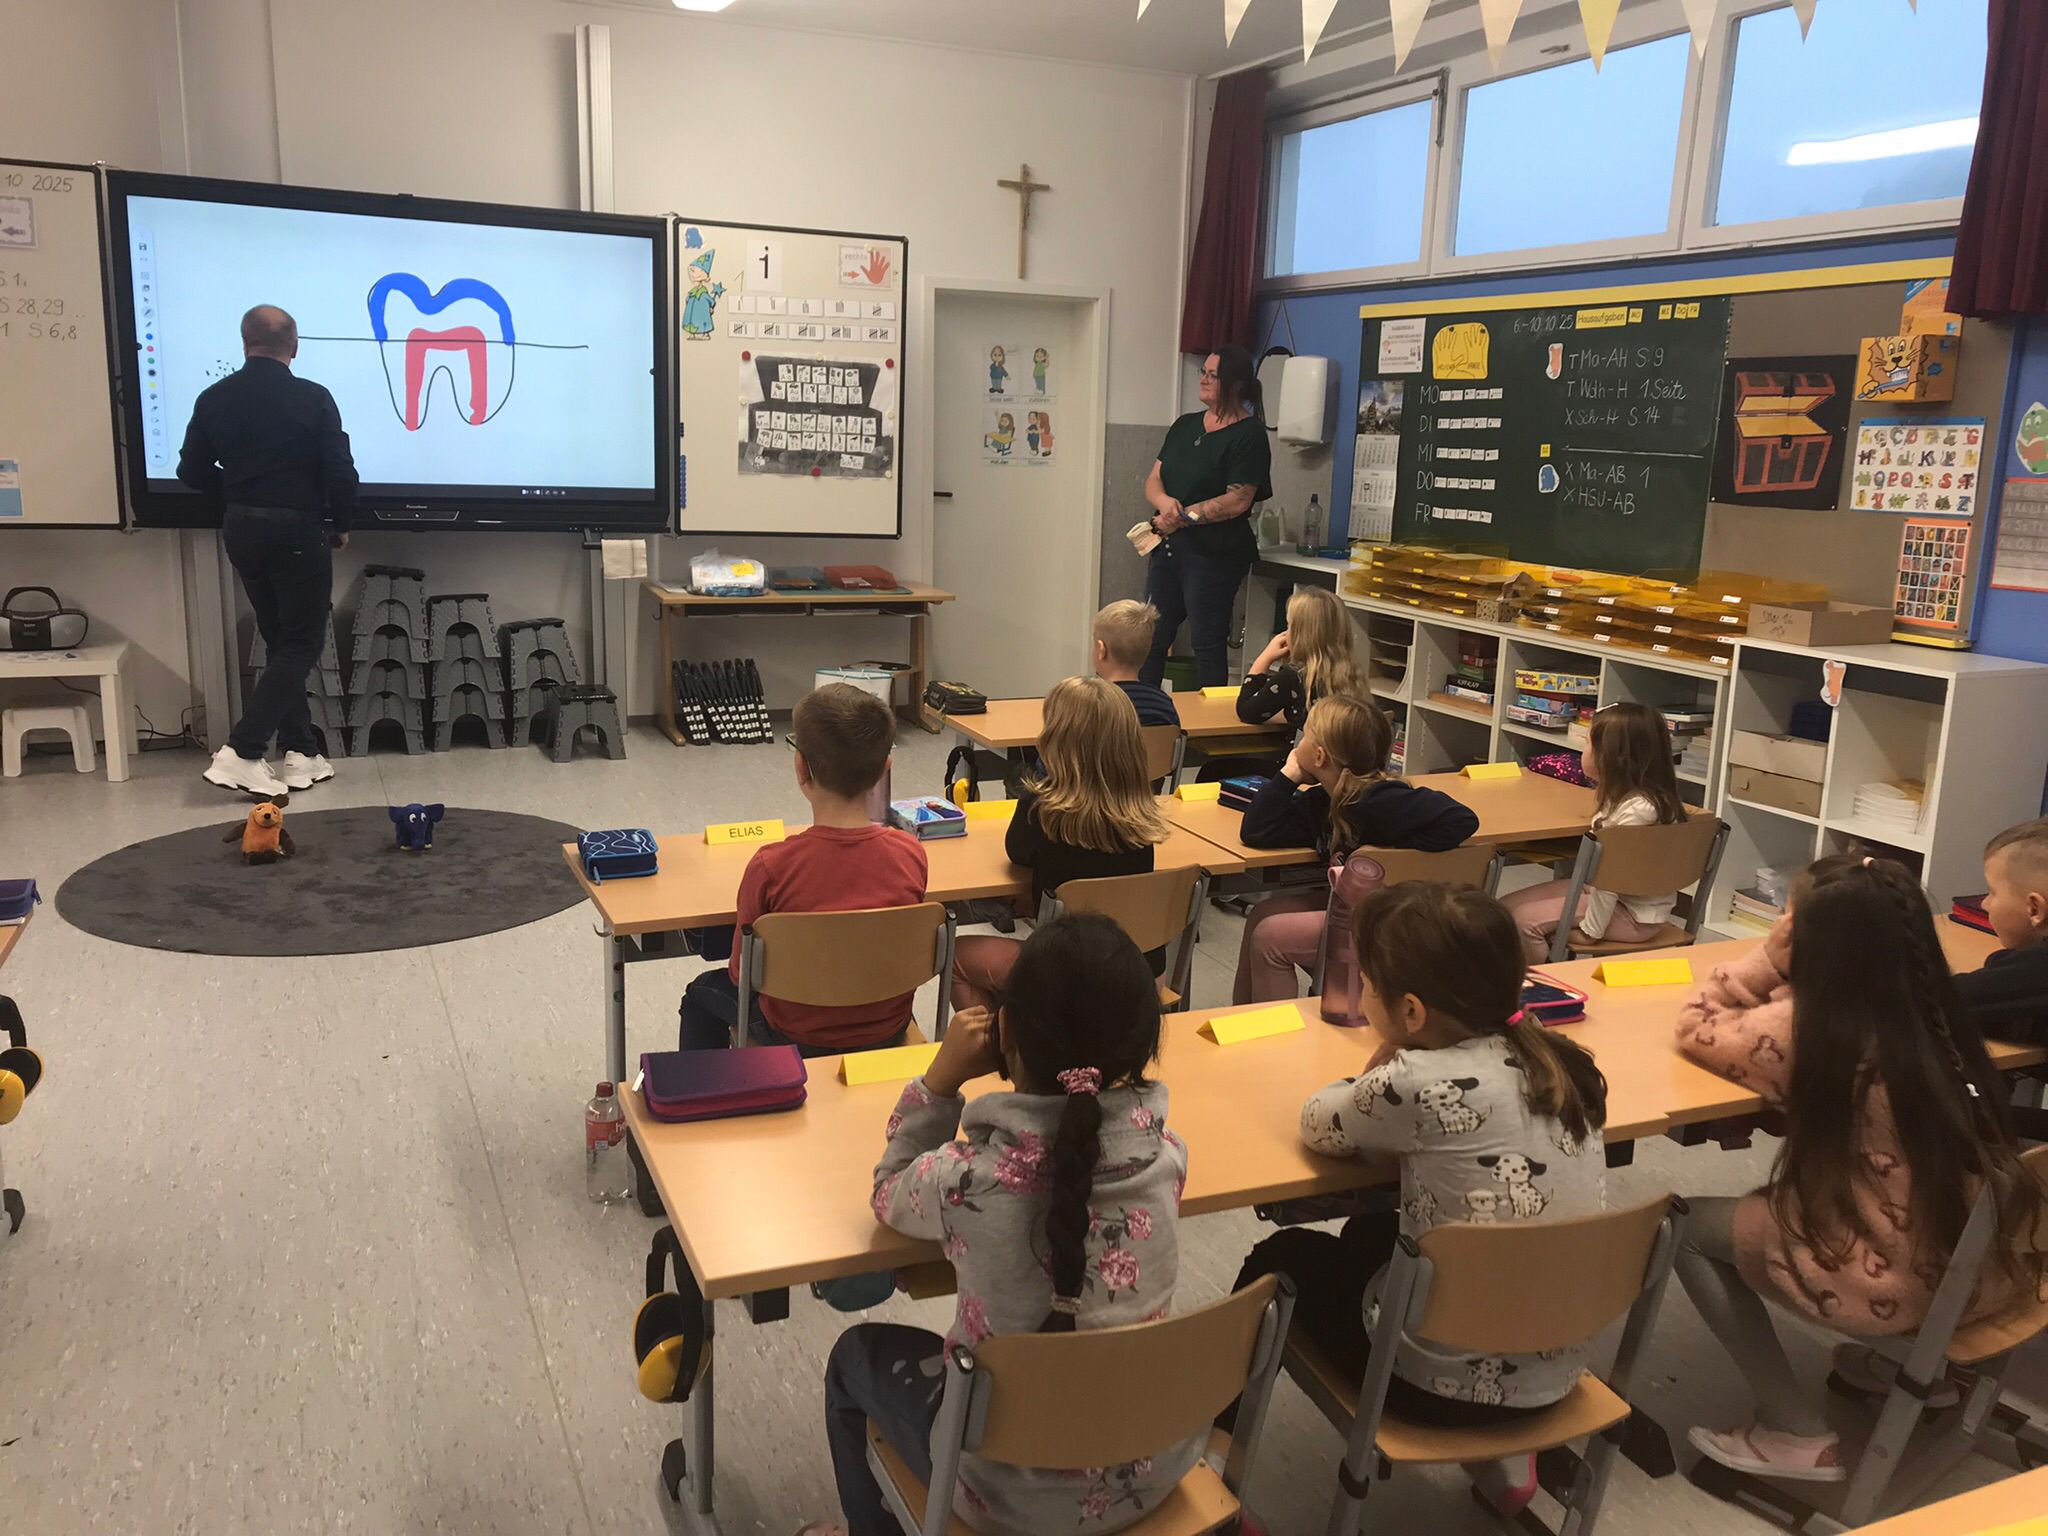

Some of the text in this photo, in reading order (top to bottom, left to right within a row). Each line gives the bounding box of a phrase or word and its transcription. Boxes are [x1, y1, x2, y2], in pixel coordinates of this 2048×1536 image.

[5, 173, 74, 192] 10 2025
[16, 298, 64, 318] 28,29
[1577, 311, 1626, 325] Hausaufgaben
[29, 322, 42, 339] S
[49, 322, 77, 341] 6,8
[1580, 347, 1628, 370] Ma-AH
[1653, 347, 1664, 367] 9
[1420, 385, 1440, 405] MO
[1567, 381, 1576, 398] T
[1640, 378, 1650, 398] 1
[1650, 378, 1688, 400] Seite
[1420, 415, 1432, 433] DI
[1643, 405, 1661, 424] 14
[1418, 443, 1433, 462] MI
[1917, 450, 1936, 467] K
[1416, 470, 1434, 490] DO
[1580, 462, 1626, 484] Ma-AB
[1639, 466, 1651, 489] 1
[1887, 471, 1899, 487] P
[1900, 471, 1914, 488] Q
[1938, 472, 1953, 489] S
[1578, 487, 1636, 515] HSU-AB
[1415, 502, 1431, 525] FR
[729, 826, 763, 838] ELIAS
